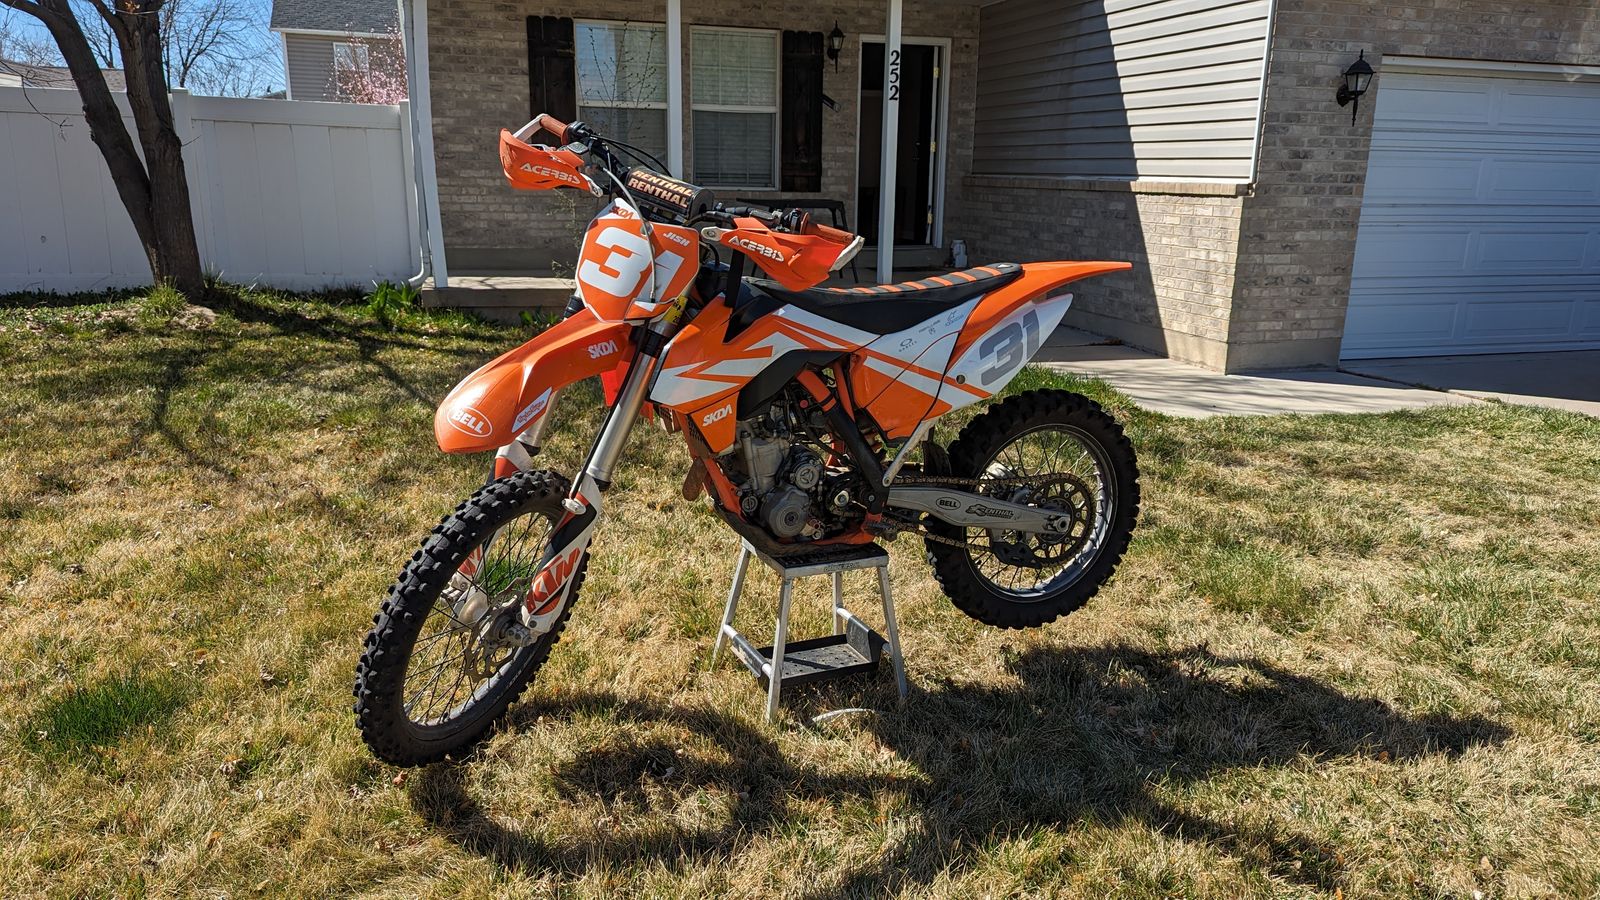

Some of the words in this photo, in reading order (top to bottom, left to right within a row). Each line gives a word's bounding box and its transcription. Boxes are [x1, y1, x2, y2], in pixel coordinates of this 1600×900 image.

[889, 50, 900, 101] 252
[520, 163, 580, 184] ACERBIS
[631, 170, 694, 197] RENTHAL
[628, 178, 688, 208] RENTHAL
[728, 235, 784, 262] ACERBIS
[580, 227, 685, 312] 31
[587, 340, 618, 360] SKDA
[979, 309, 1040, 386] 31
[451, 407, 485, 435] BELL
[702, 403, 733, 427] SKDA
[939, 499, 958, 508] BELL
[526, 547, 581, 614] KTM
